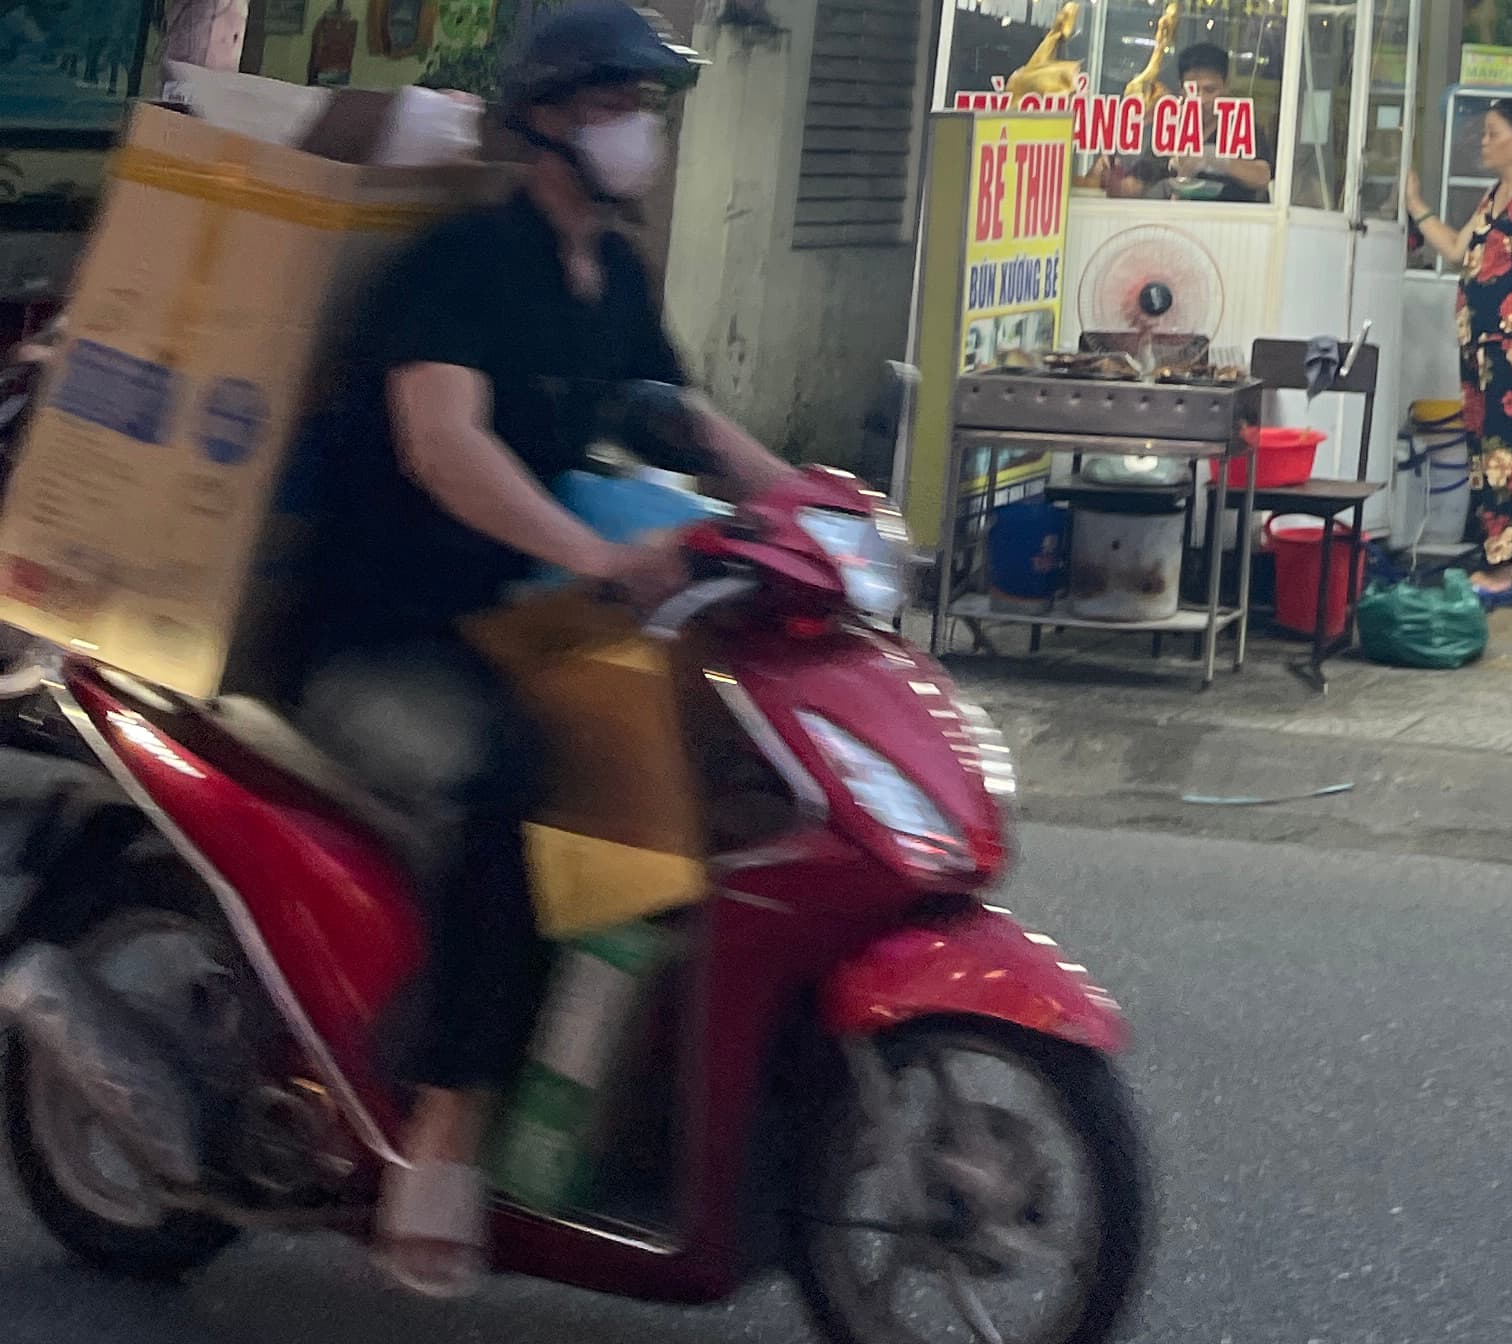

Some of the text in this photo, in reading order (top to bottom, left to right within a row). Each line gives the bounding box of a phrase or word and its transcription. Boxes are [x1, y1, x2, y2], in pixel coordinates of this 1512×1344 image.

[1153, 82, 1203, 154] GÀ
[1215, 99, 1253, 155] TA
[975, 126, 1066, 243] BÊ THUI
[968, 258, 997, 311] BÚN
